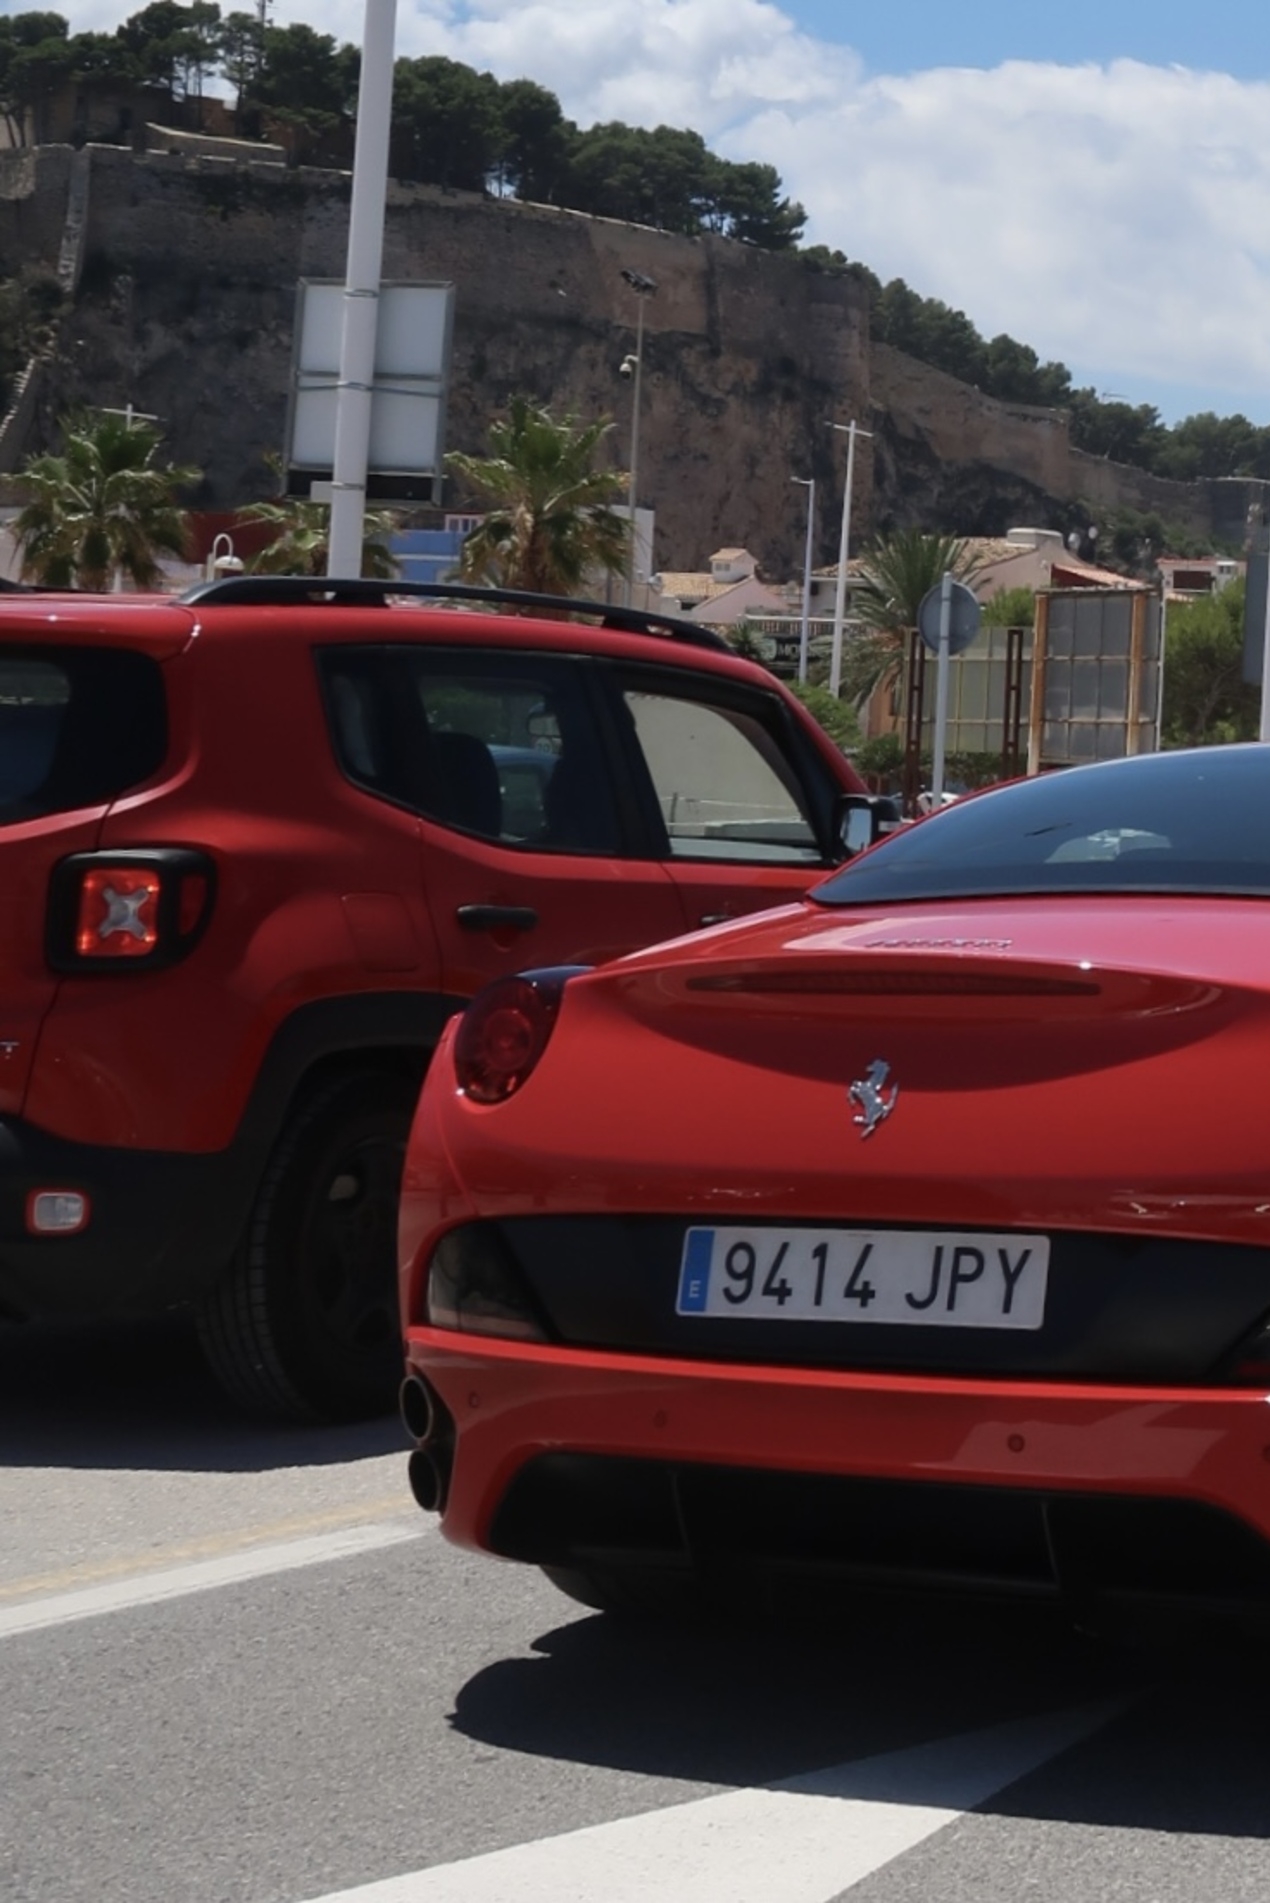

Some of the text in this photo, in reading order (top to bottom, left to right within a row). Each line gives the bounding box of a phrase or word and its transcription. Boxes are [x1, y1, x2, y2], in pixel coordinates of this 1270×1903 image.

[688, 1280, 701, 1298] E
[722, 1241, 1032, 1314] 9414 JPY
